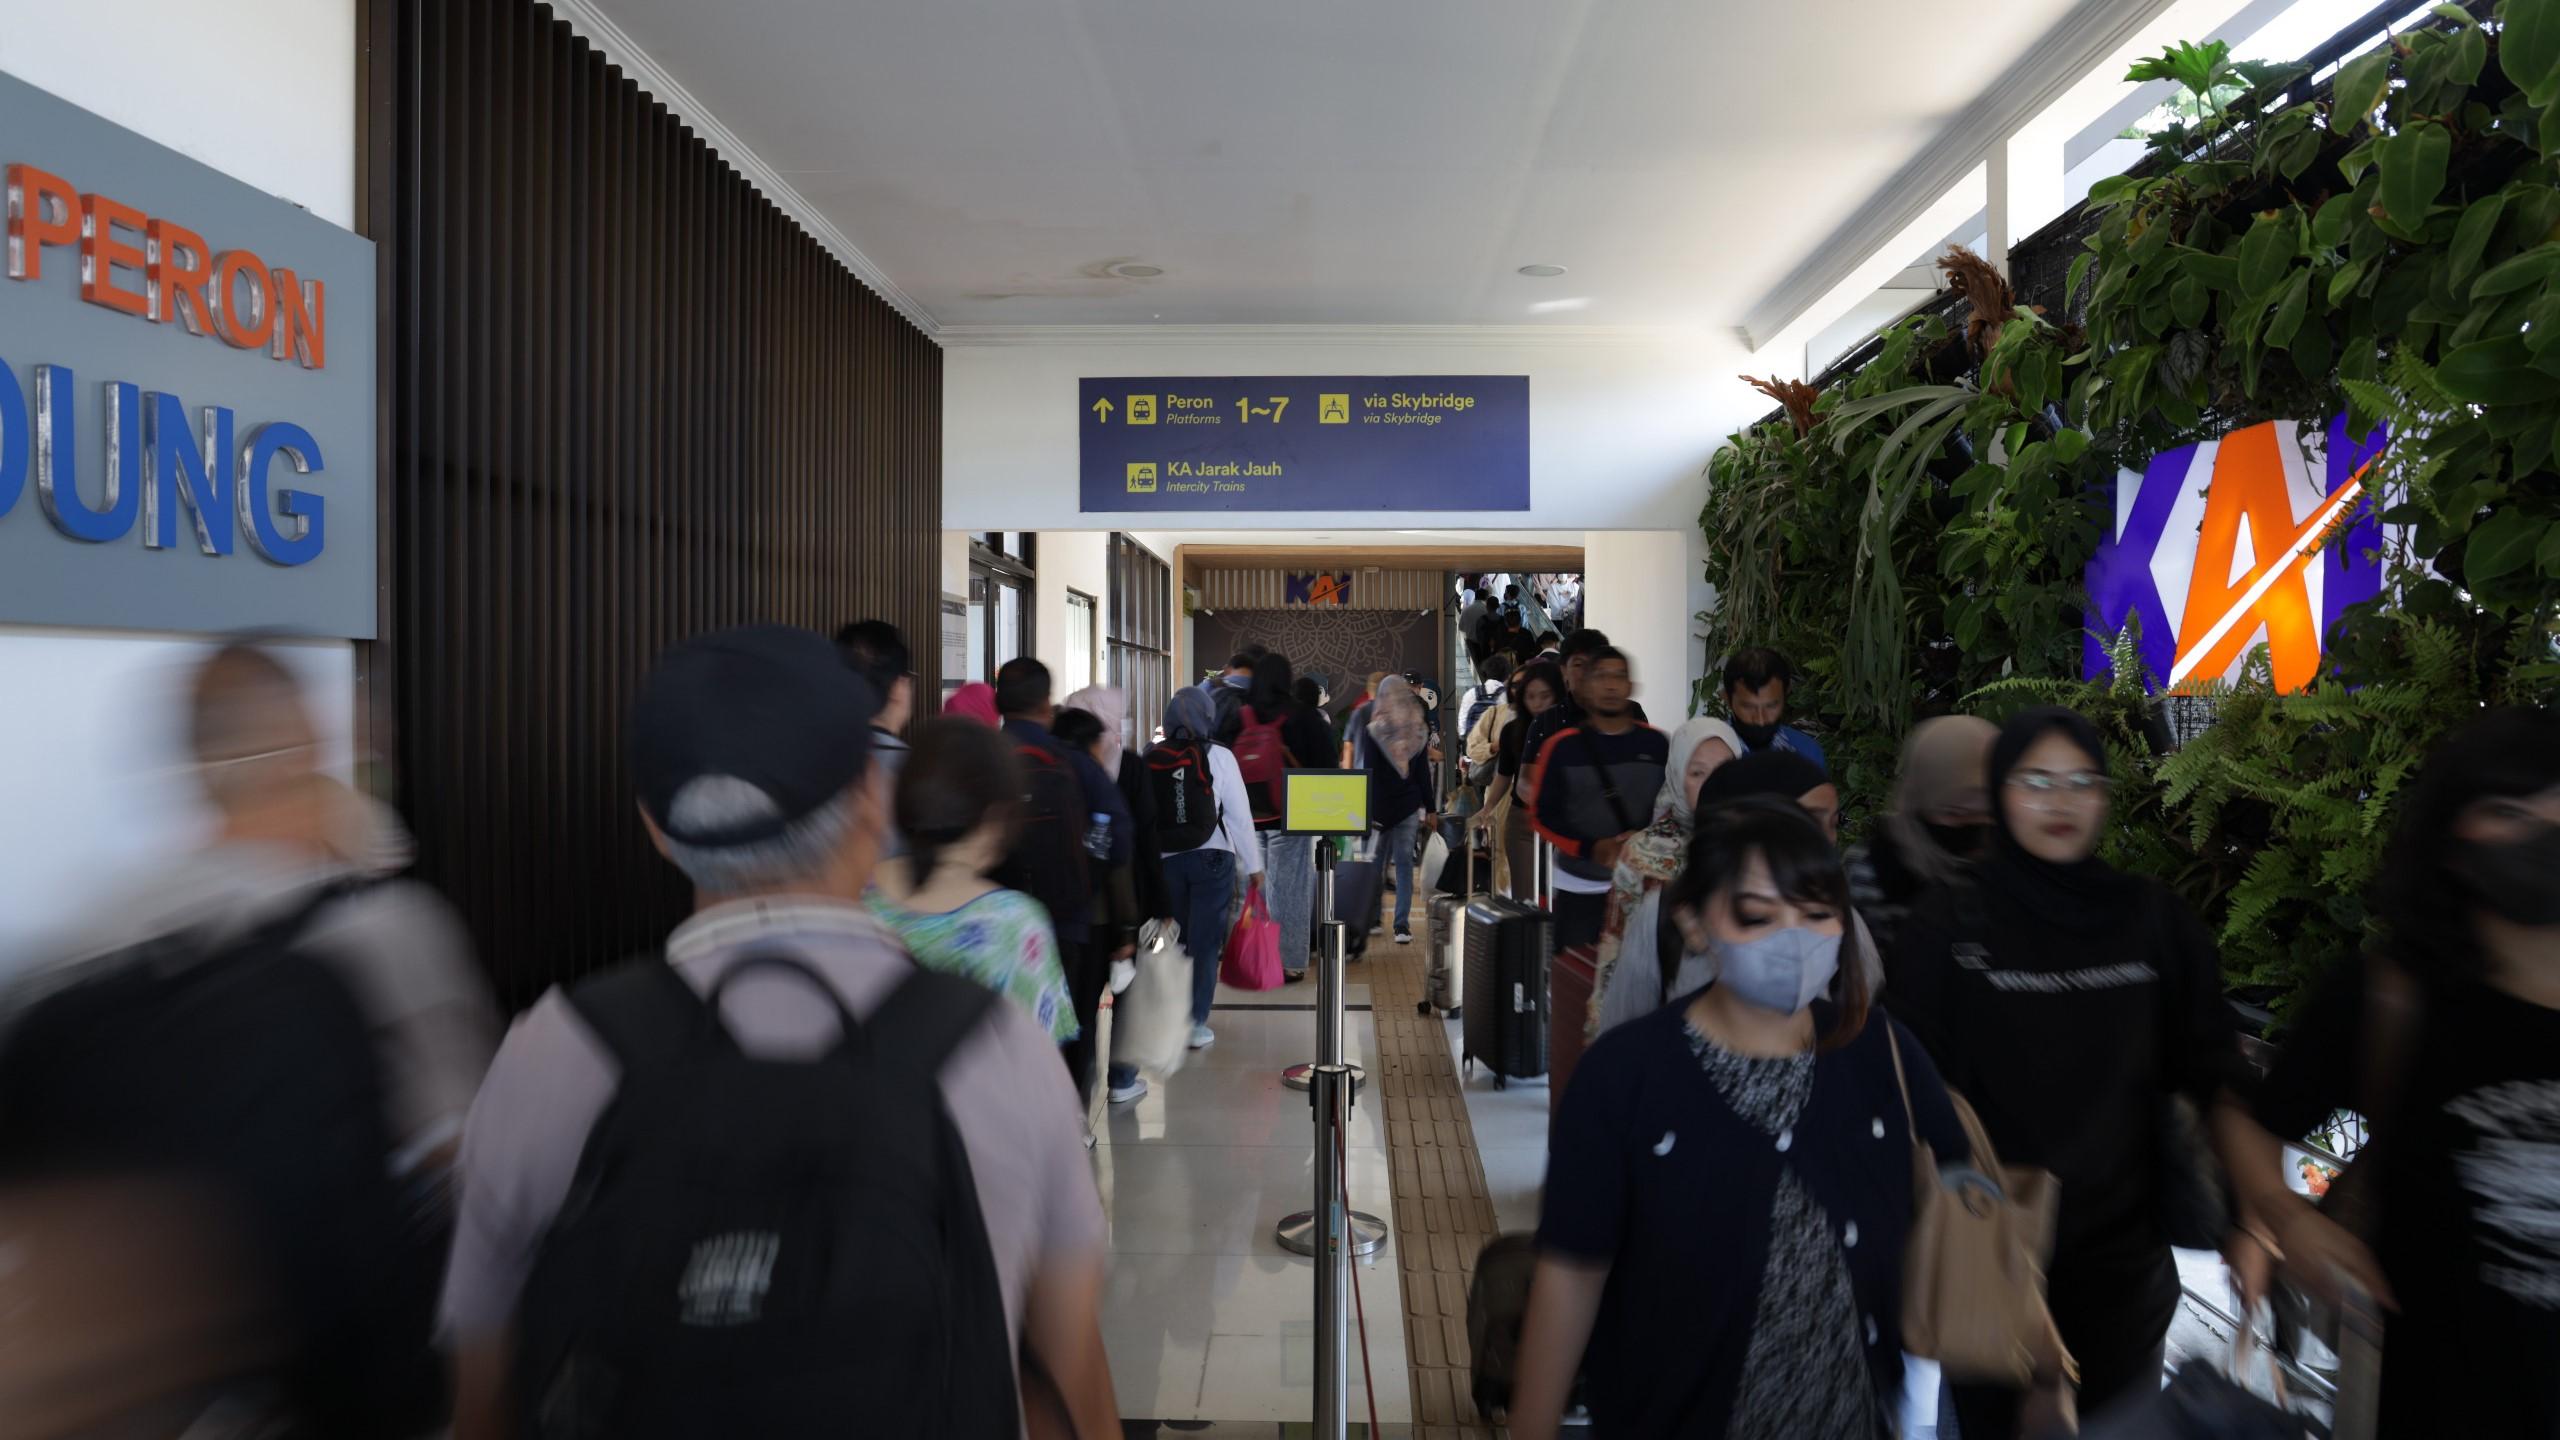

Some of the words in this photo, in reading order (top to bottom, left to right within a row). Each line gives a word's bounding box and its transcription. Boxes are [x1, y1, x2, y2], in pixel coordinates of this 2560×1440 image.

[7, 163, 325, 370] PERON
[1166, 394, 1214, 410] Peron
[1363, 393, 1388, 408] via
[1391, 393, 1475, 411] Skybridge
[1166, 413, 1222, 424] Platforms
[1363, 413, 1380, 423] via
[1383, 412, 1442, 426] Skybridge
[1167, 462, 1192, 476] KA
[1195, 461, 1240, 477] Jarak
[1243, 461, 1282, 477] Jauh
[1166, 481, 1210, 493] Intercity
[1213, 481, 1246, 492] Trains
[2083, 410, 2388, 697] KAI
[1286, 575, 1351, 606] KAI
[1175, 782, 1187, 824] Reebok
